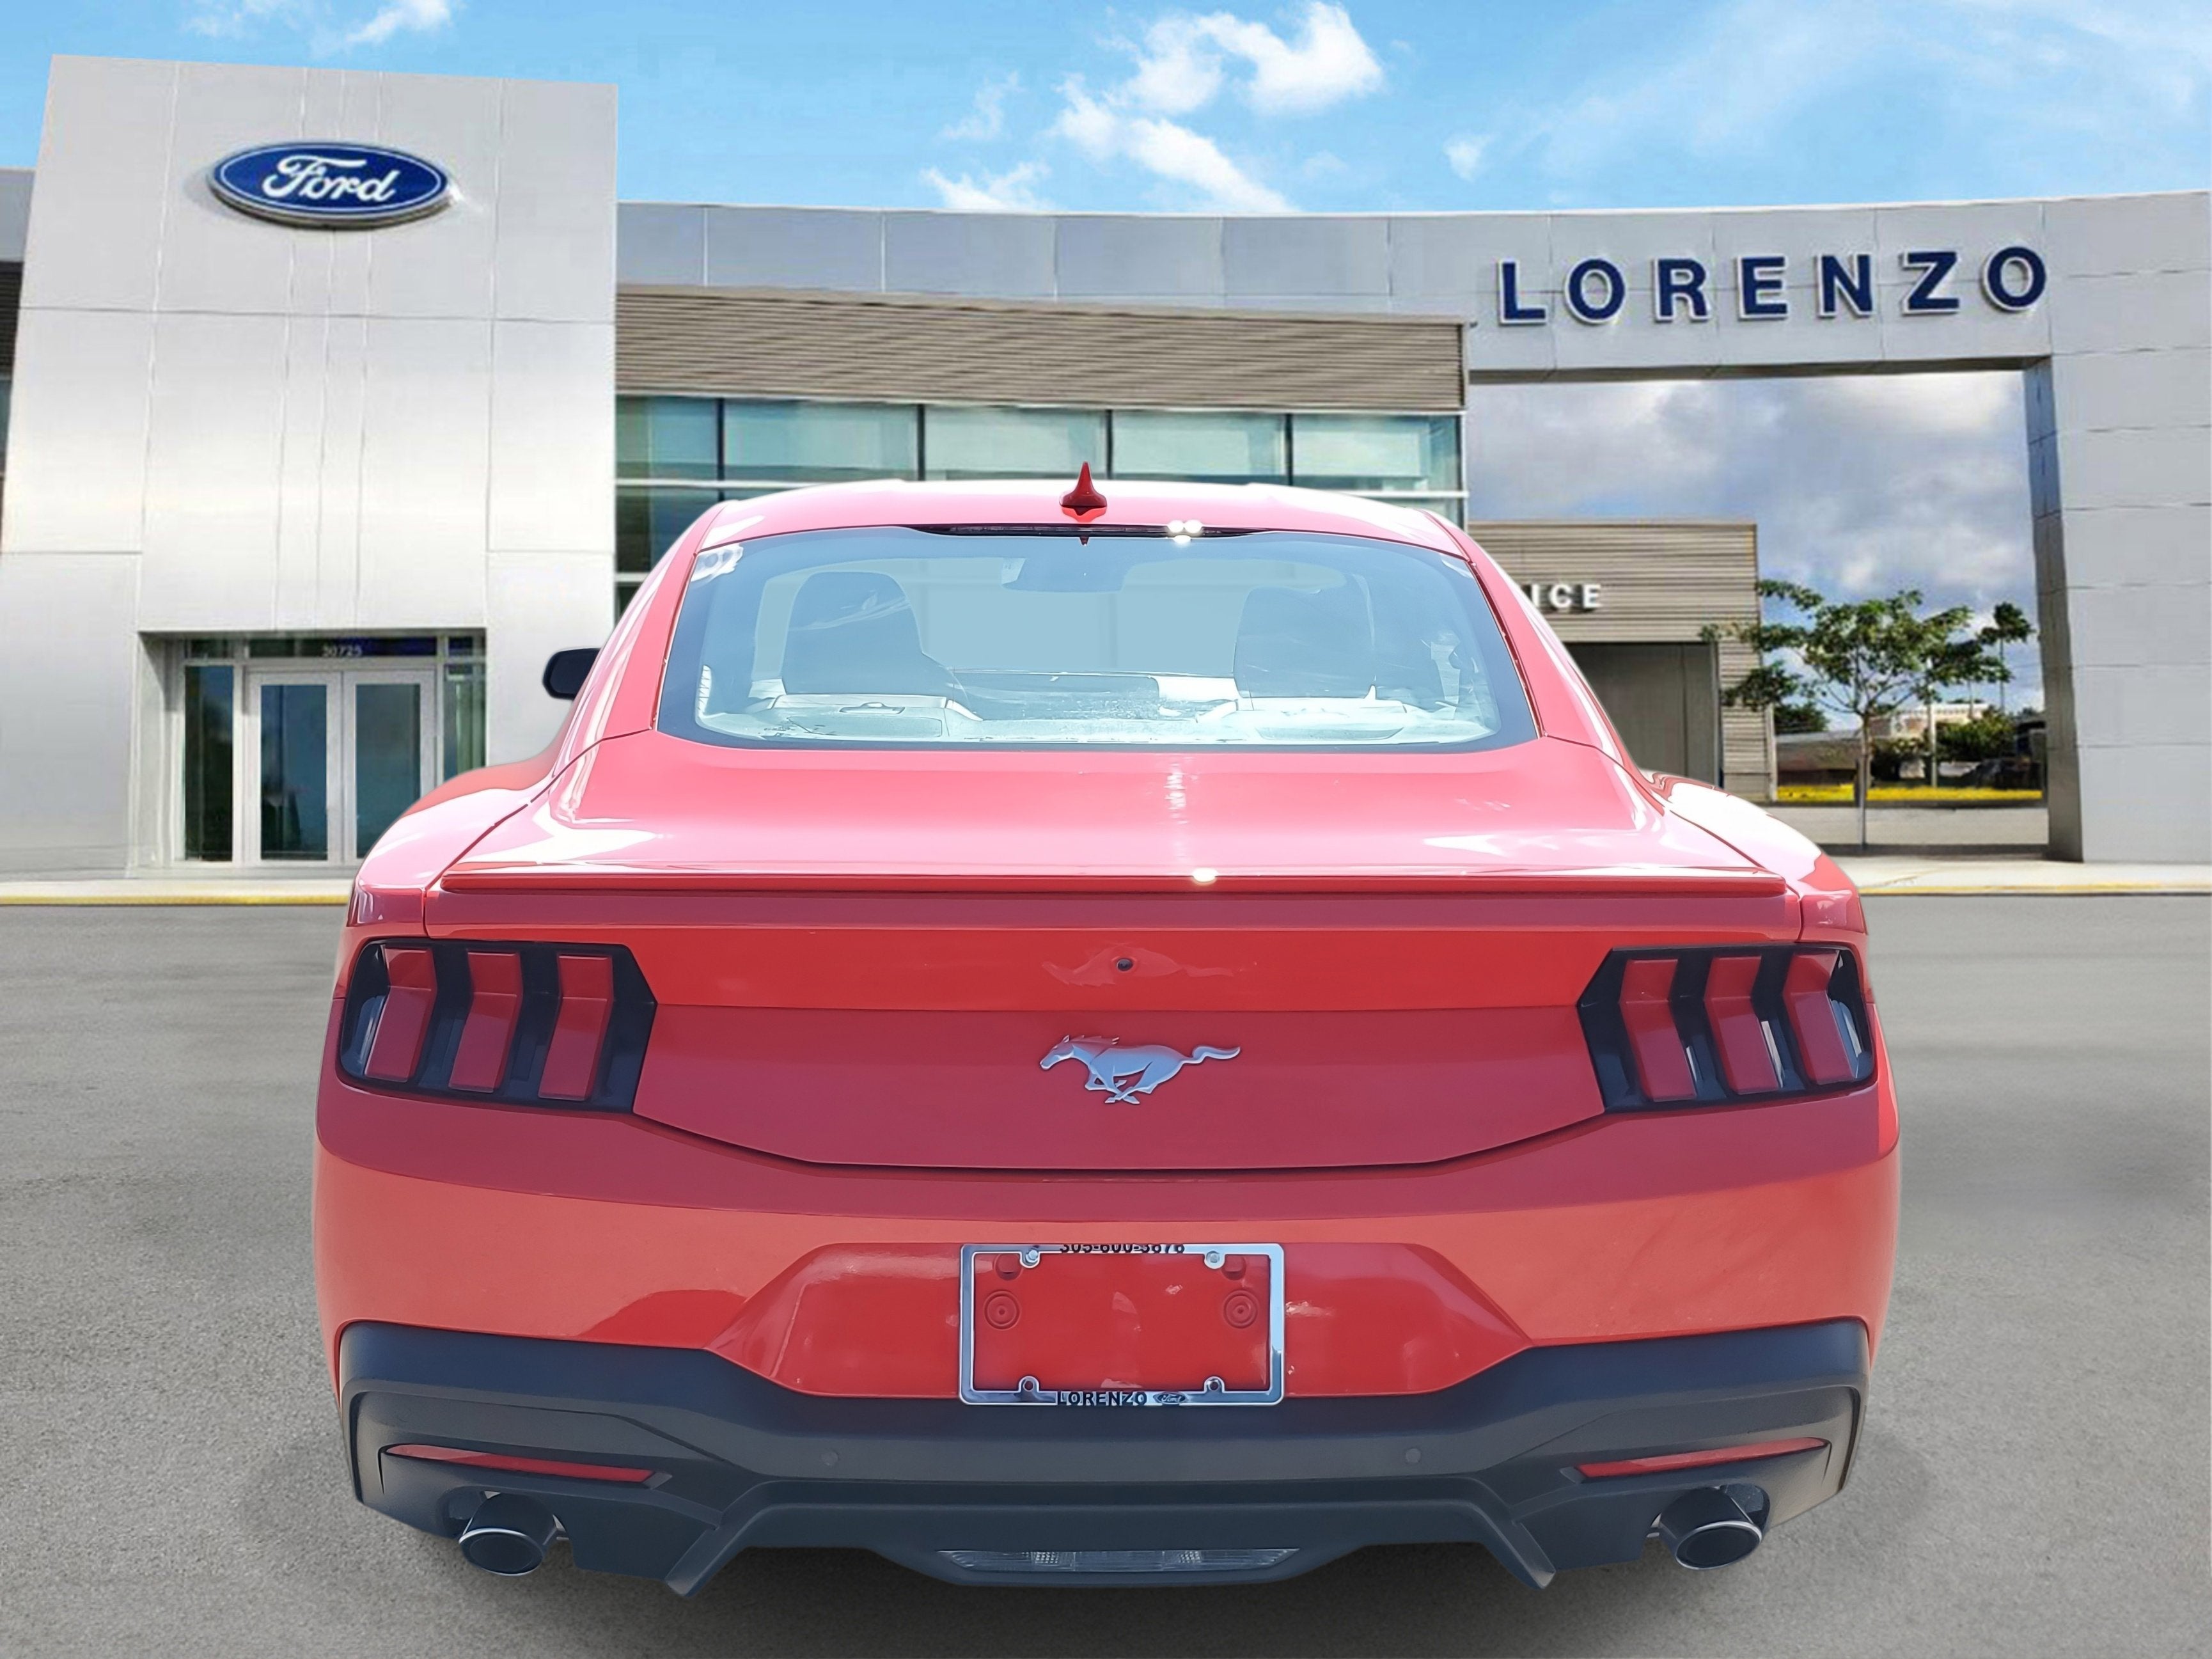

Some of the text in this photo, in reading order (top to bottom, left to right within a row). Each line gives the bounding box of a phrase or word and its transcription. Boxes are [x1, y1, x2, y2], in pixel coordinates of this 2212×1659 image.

[262, 154, 400, 201] Ford
[1499, 245, 2046, 325] LORENZO
[1058, 1391, 1147, 1406] LORENZO
